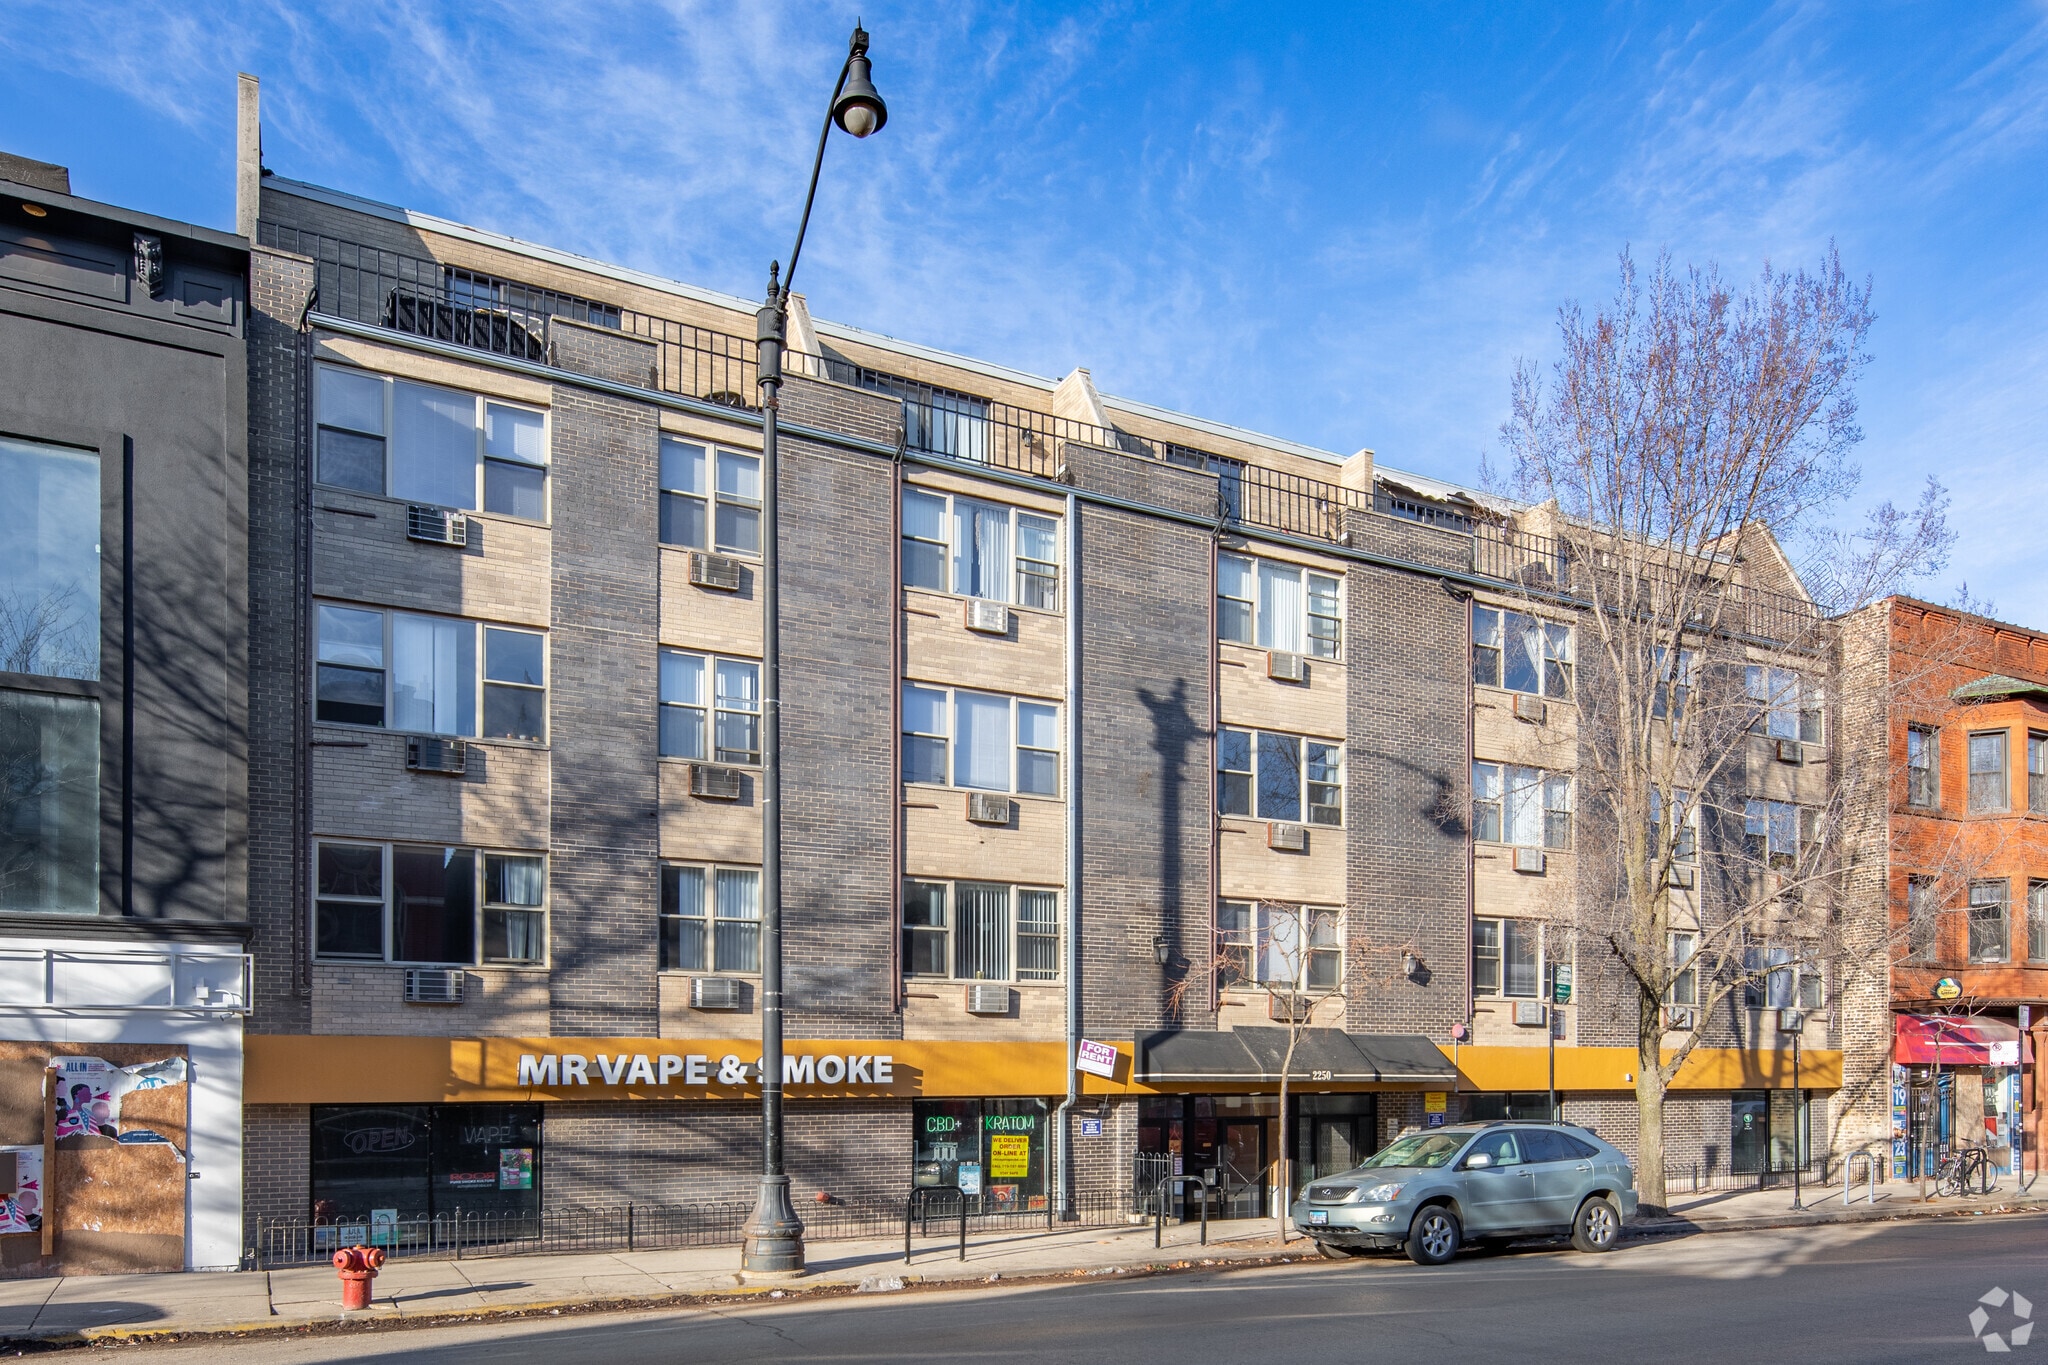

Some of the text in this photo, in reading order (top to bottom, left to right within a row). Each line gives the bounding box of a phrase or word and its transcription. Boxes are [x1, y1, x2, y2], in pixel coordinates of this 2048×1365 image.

[1081, 1049, 1112, 1065] RENT
[1087, 1043, 1110, 1056] FOR
[66, 1062, 78, 1072] ALL
[80, 1062, 87, 1072] IN
[519, 1054, 589, 1086] MR
[596, 1054, 708, 1085] VAPE
[717, 1054, 748, 1084] &
[1312, 1070, 1331, 1080] 2250
[1895, 1088, 1906, 1106] 19
[985, 1115, 1034, 1130] KRATOM
[351, 1126, 409, 1153] OPEN
[464, 1126, 511, 1144] VAPE
[1895, 1141, 1905, 1156] 23
